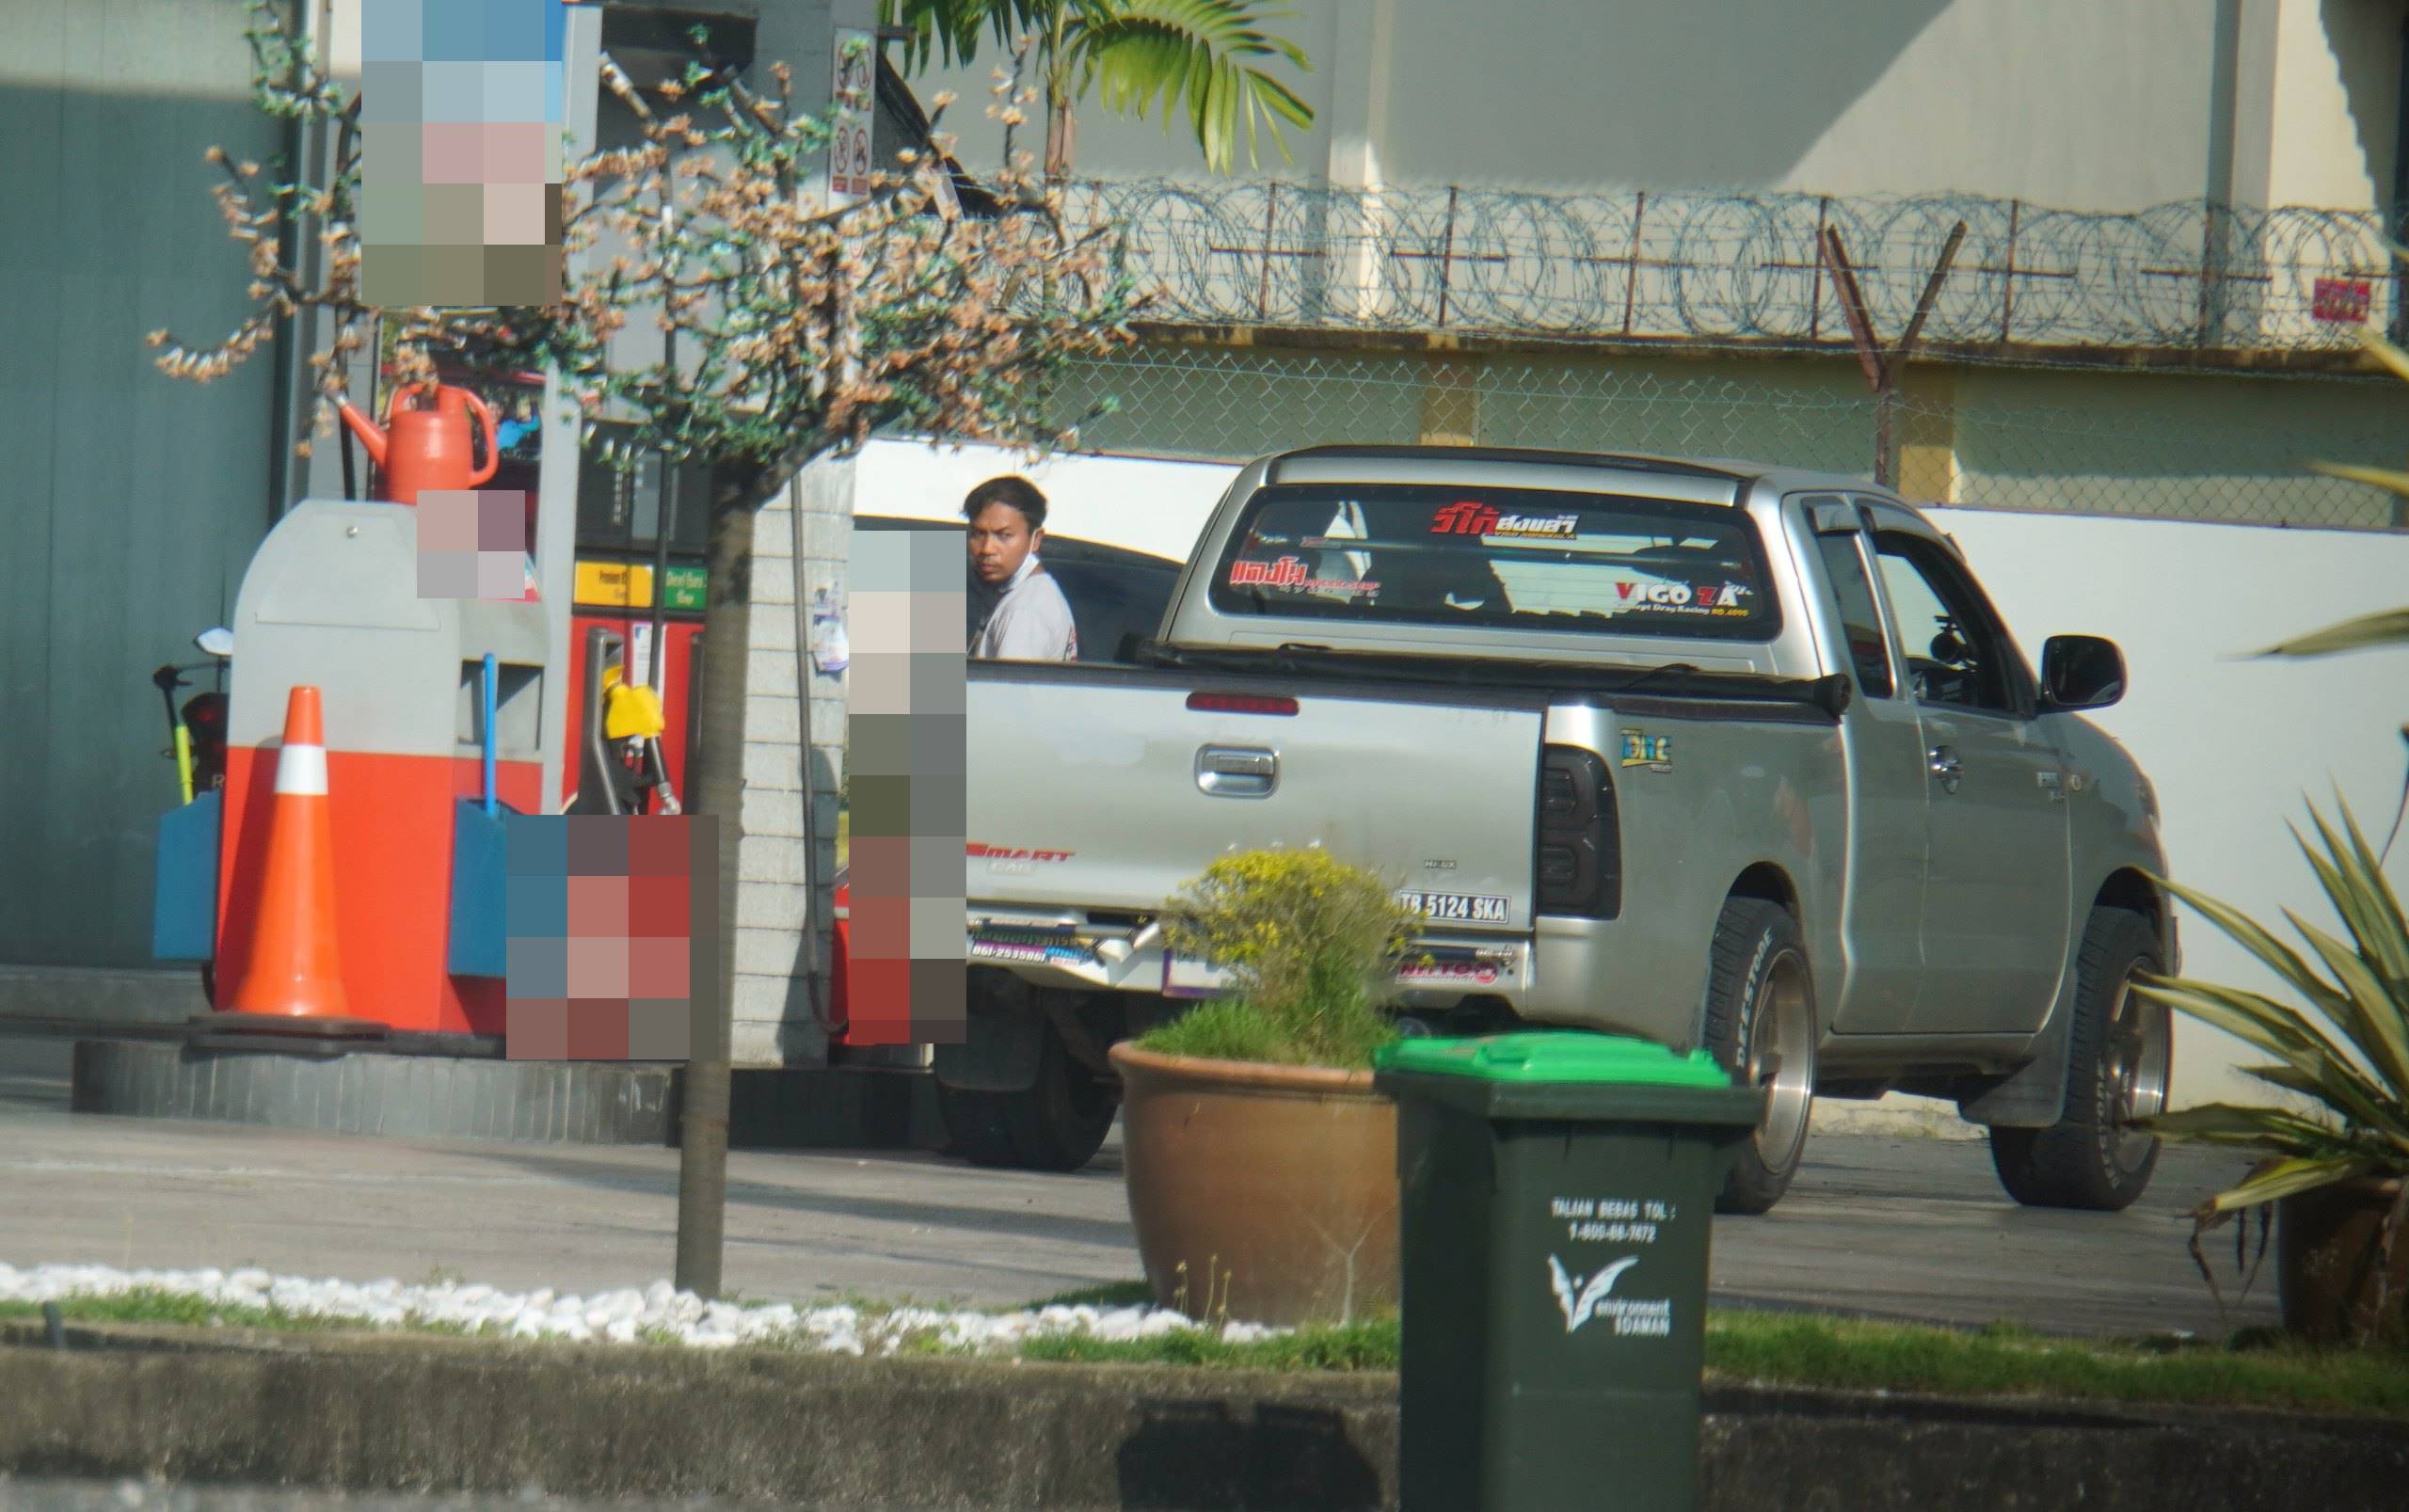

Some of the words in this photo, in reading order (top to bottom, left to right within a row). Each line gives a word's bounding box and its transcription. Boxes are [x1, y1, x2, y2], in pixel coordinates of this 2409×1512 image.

[1615, 581, 1692, 605] VIGO
[1427, 895, 1469, 918] 5124
[1473, 898, 1507, 920] SKA
[1552, 1198, 1594, 1218] TALIAN
[1599, 1200, 1638, 1219] BEBAS
[1615, 1317, 1670, 1337] IDAMAN
